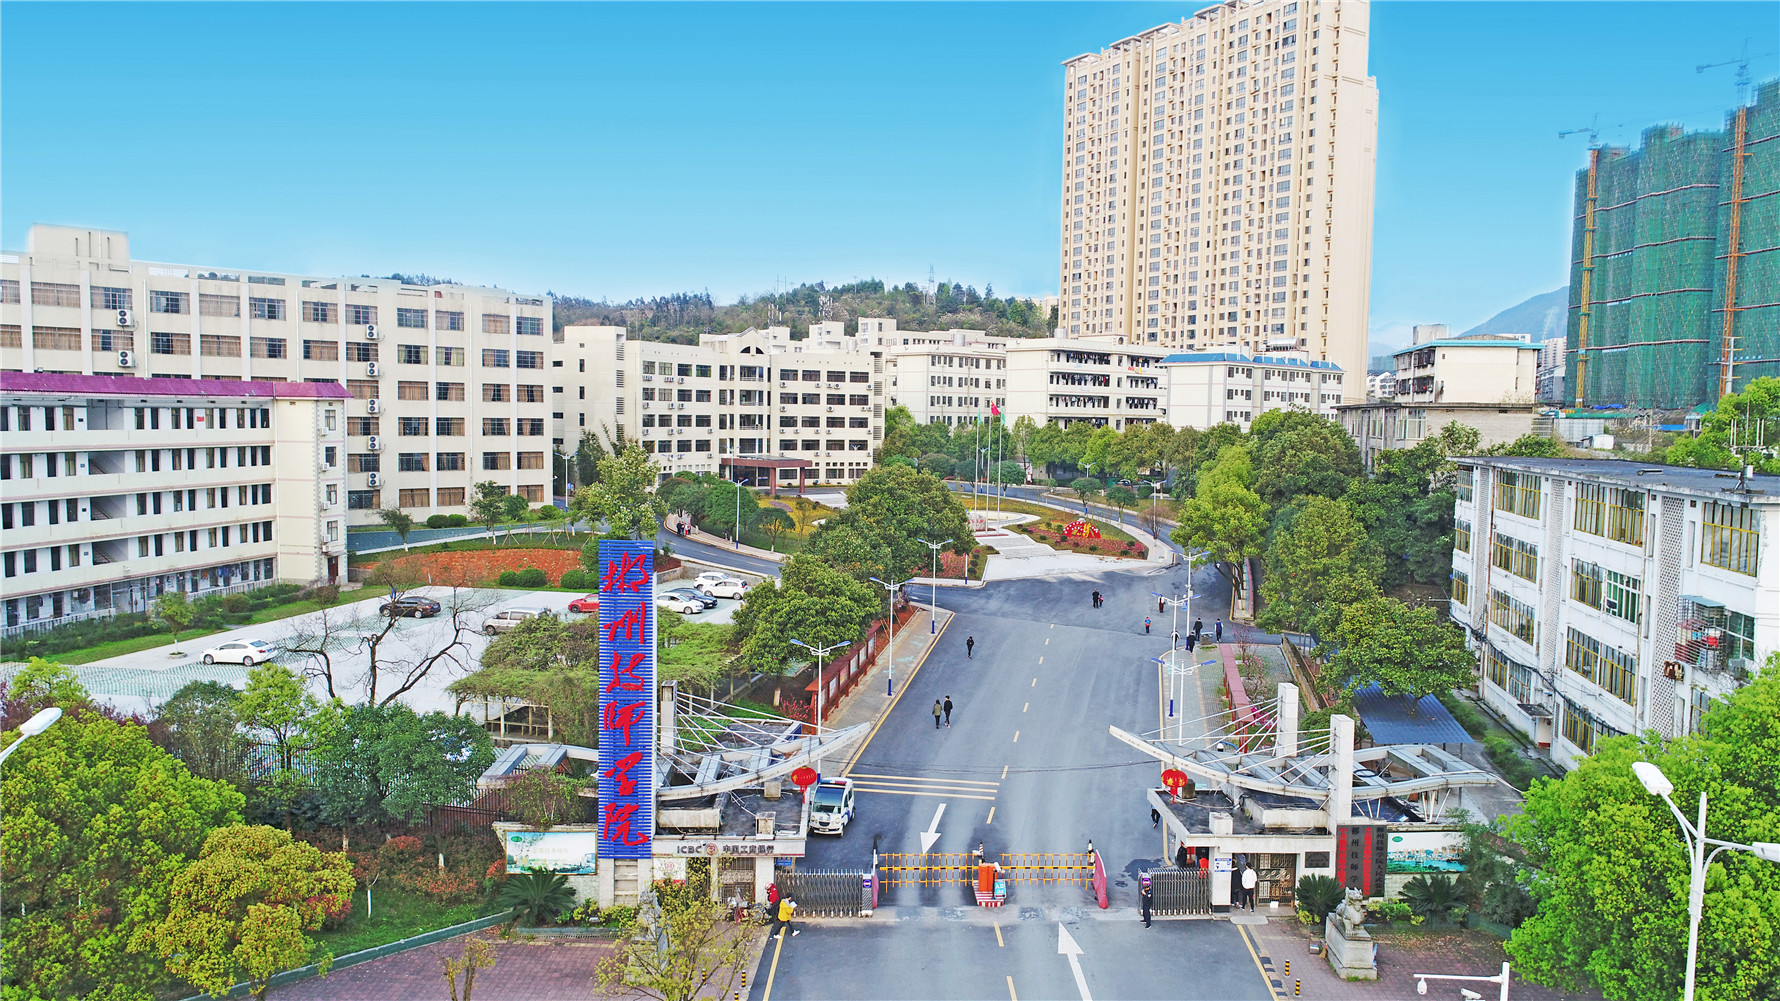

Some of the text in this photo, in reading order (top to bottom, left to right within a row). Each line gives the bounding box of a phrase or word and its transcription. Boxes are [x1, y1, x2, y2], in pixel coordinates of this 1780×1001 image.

[602, 551, 650, 846] 郴州技师学院
[677, 844, 775, 854] ICBC 中国工商银行
[1350, 826, 1360, 884] 郴州技师学
